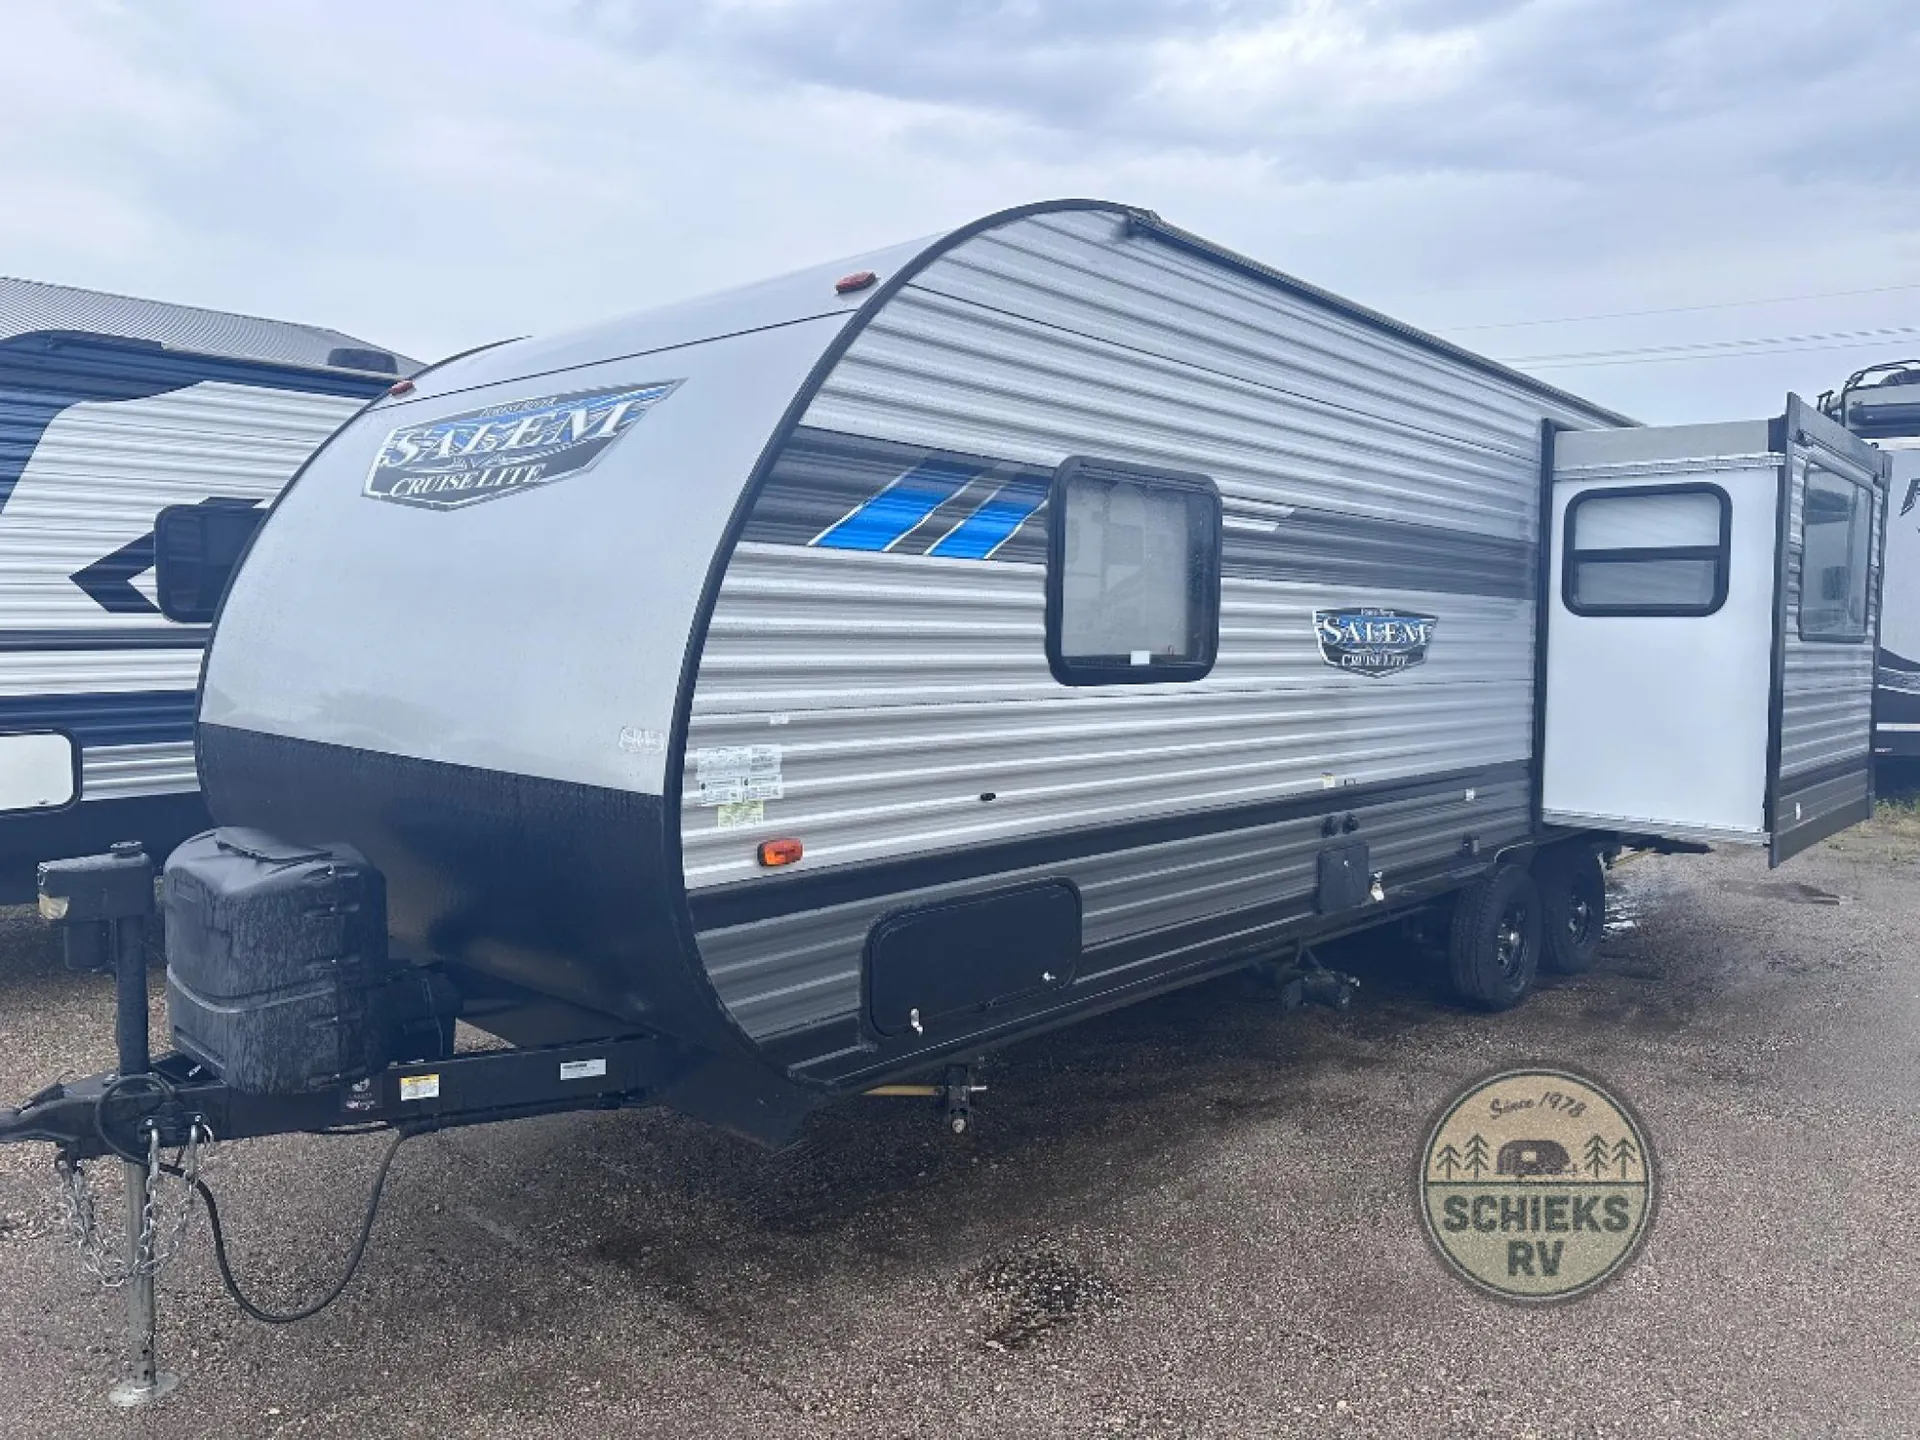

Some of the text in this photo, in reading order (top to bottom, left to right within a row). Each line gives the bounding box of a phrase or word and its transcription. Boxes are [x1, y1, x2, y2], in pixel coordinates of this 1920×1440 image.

[381, 400, 643, 467] SALEM
[390, 463, 547, 497] CRUISE LITE
[1322, 616, 1428, 646] SALEM
